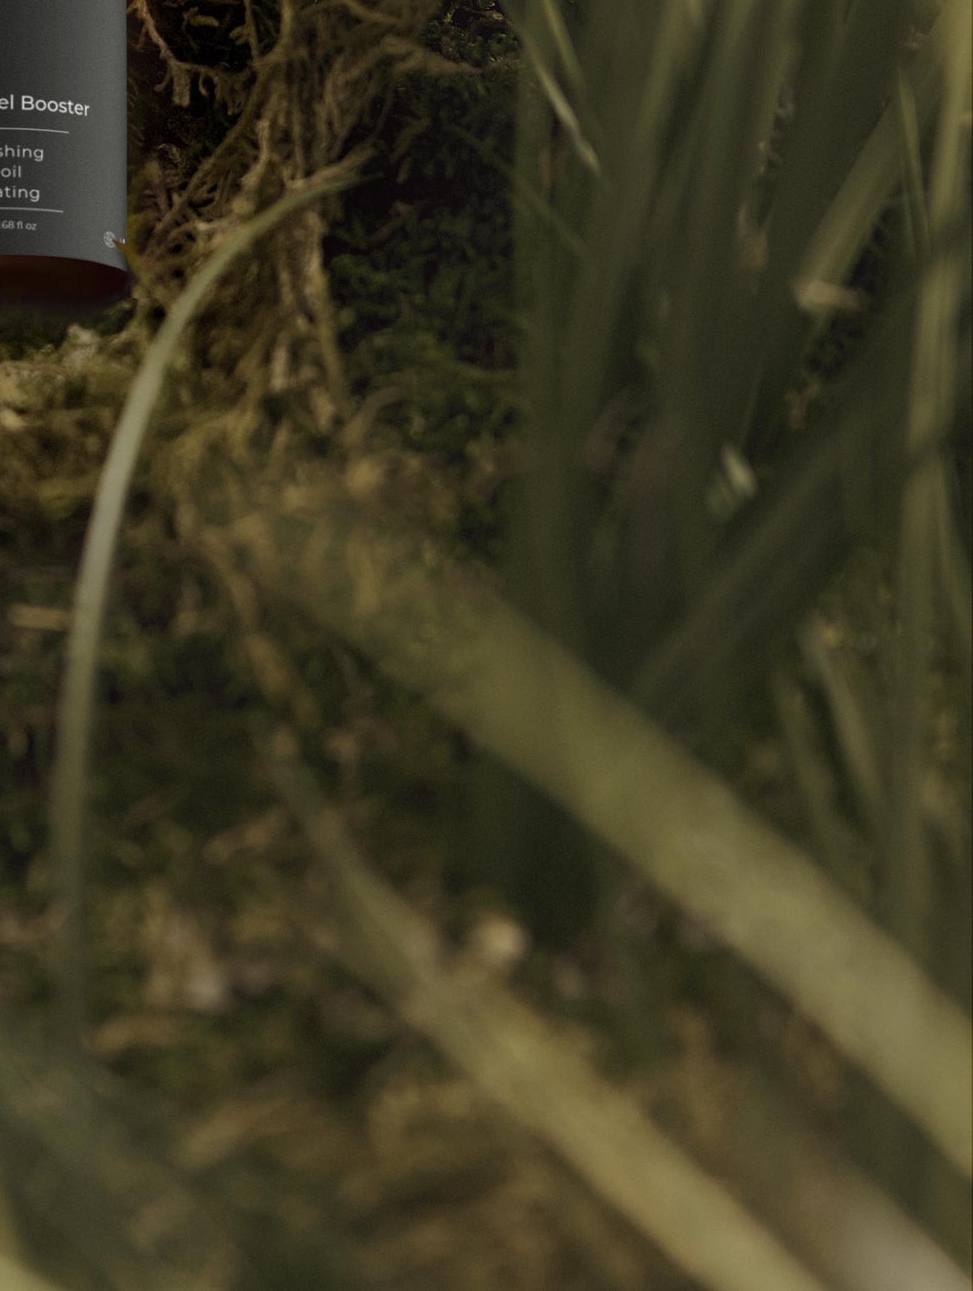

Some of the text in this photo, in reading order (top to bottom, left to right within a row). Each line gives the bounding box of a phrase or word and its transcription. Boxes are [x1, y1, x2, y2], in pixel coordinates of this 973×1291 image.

[21, 95, 90, 116] Booster
[0, 165, 22, 178] oil
[17, 220, 23, 230] fl
[25, 222, 37, 230] oz
